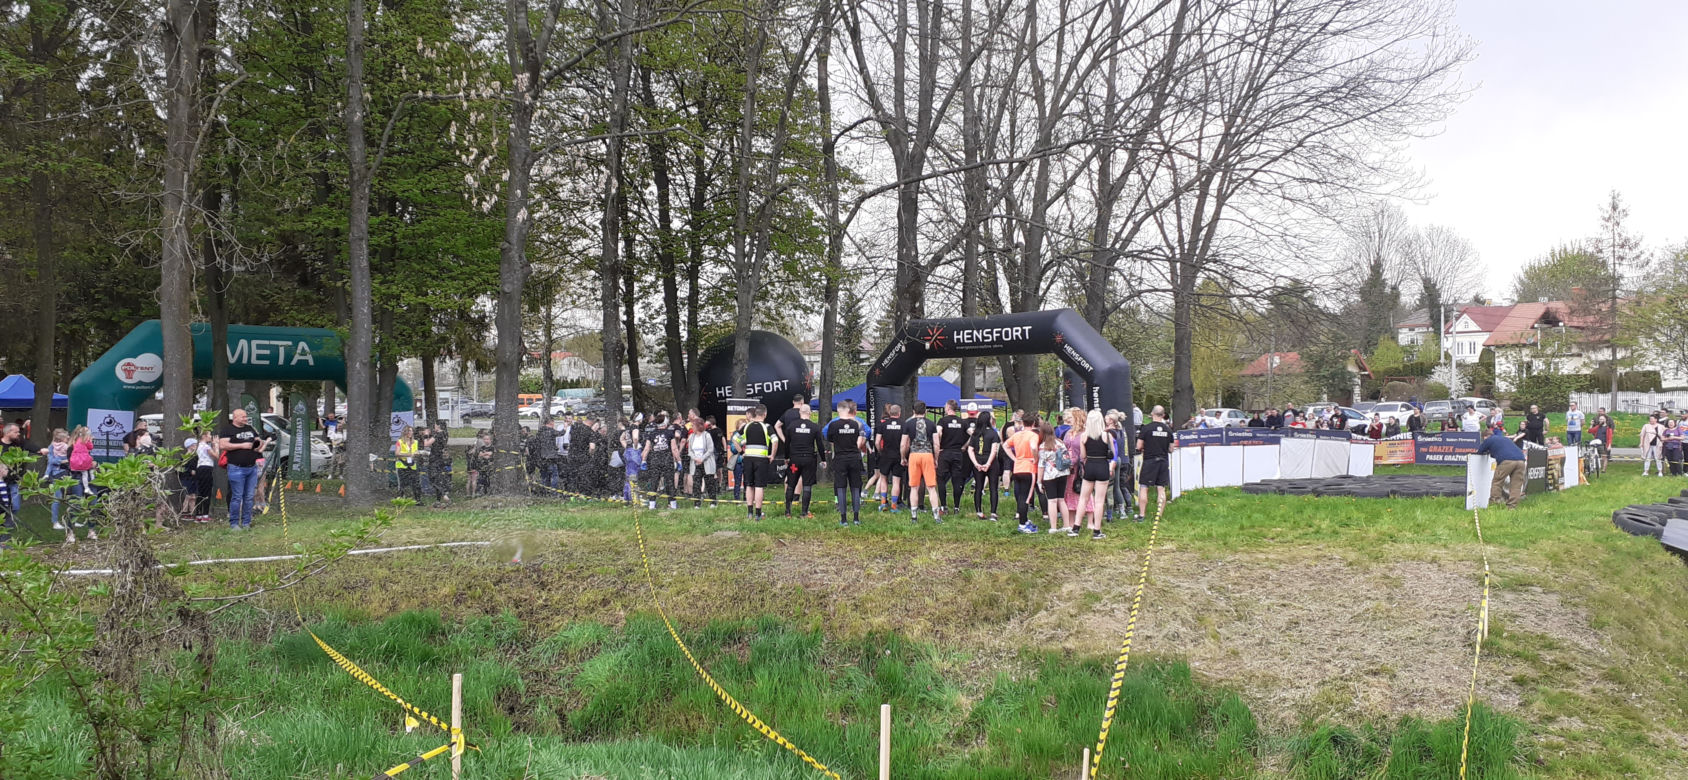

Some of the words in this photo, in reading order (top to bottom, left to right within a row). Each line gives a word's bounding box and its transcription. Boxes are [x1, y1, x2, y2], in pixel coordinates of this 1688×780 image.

[953, 326, 1032, 343] HENSFORT
[226, 339, 314, 366] META
[1063, 343, 1094, 373] HENSFORT
[715, 380, 790, 398] HESFORT
